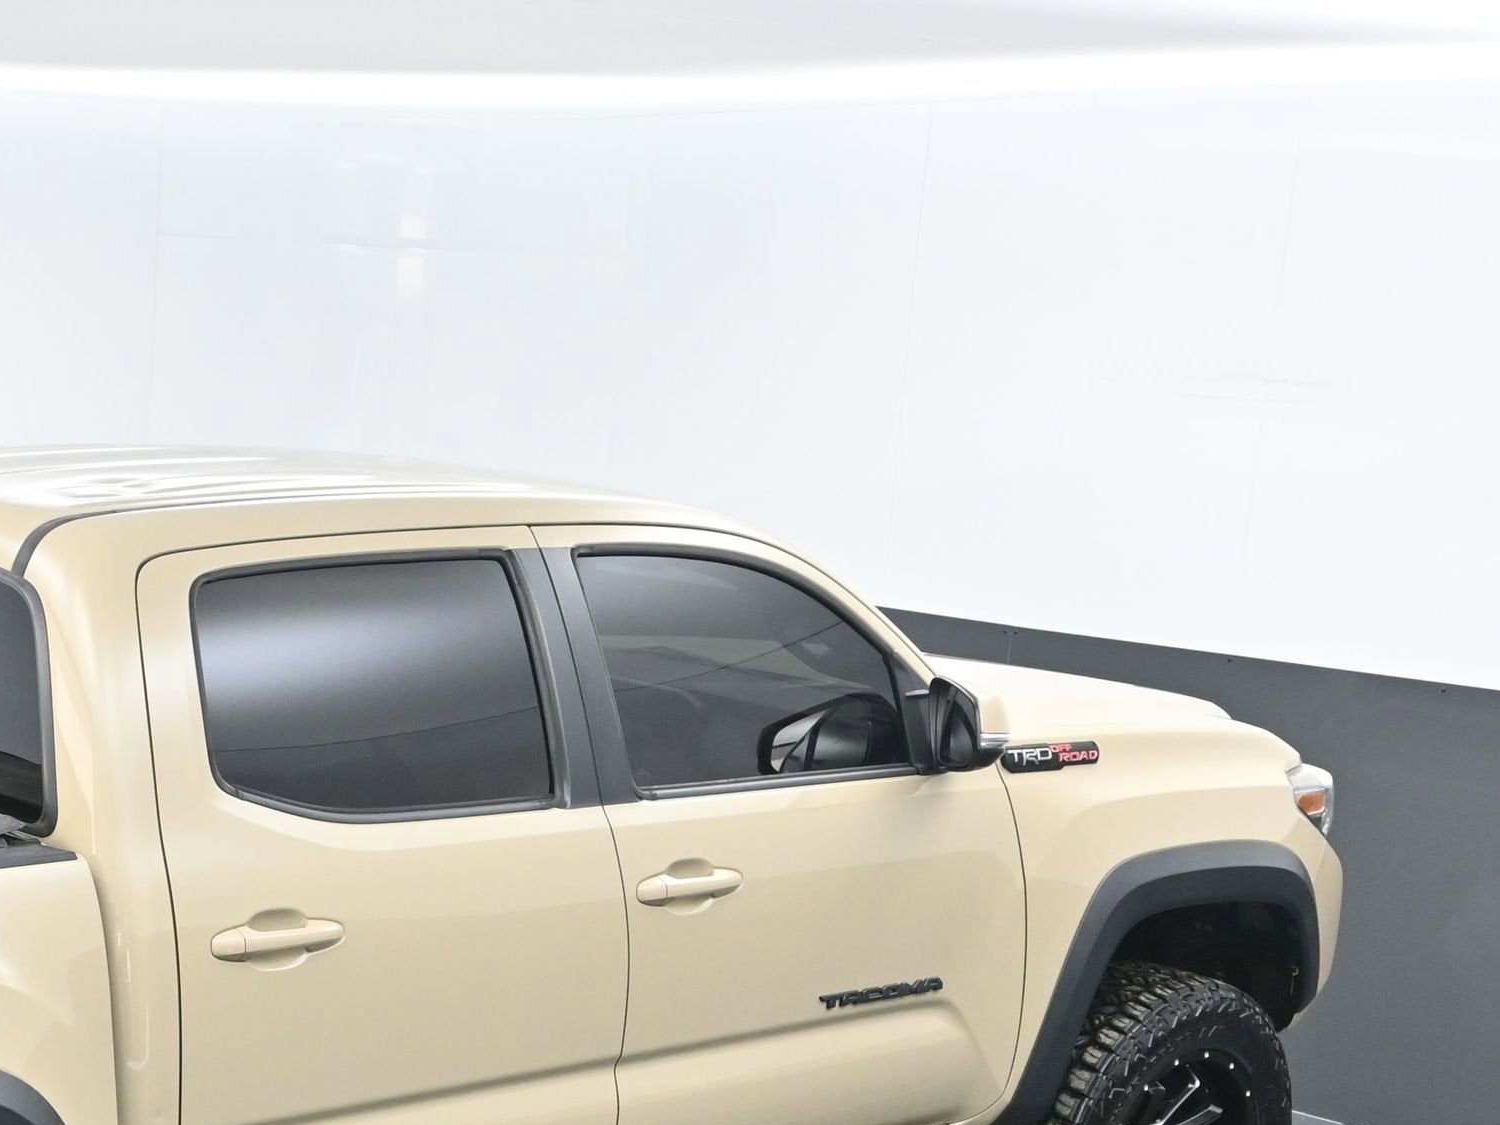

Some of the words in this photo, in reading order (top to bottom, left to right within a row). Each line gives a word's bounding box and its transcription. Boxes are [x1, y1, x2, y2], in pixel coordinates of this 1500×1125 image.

[1050, 743, 1073, 753] OFF
[1007, 748, 1053, 767] TRD
[1058, 750, 1099, 763] ROAD
[819, 977, 943, 1010] TACOMA
